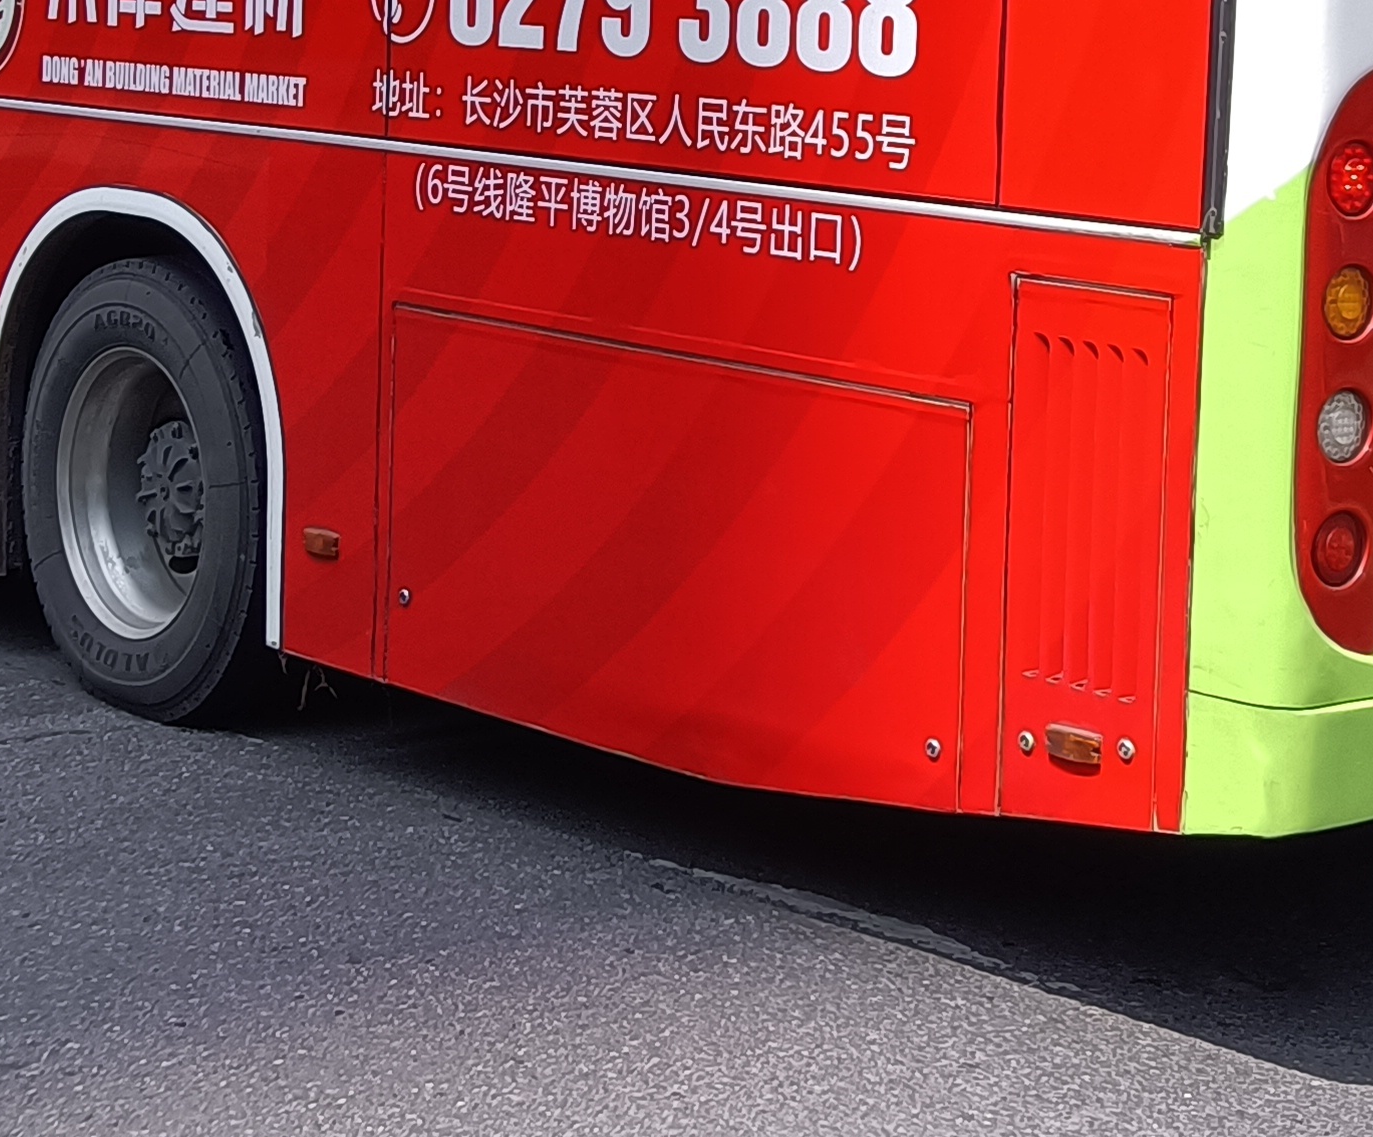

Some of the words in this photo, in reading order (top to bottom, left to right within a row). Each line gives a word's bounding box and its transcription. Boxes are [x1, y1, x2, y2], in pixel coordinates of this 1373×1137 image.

[42, 55, 78, 85] DONG
[105, 60, 170, 94] BUILDING
[172, 66, 242, 101] MATERIAL
[244, 72, 307, 107] MARKET
[414, 162, 863, 271] (6号线隆平博物馆3/4号出口)
